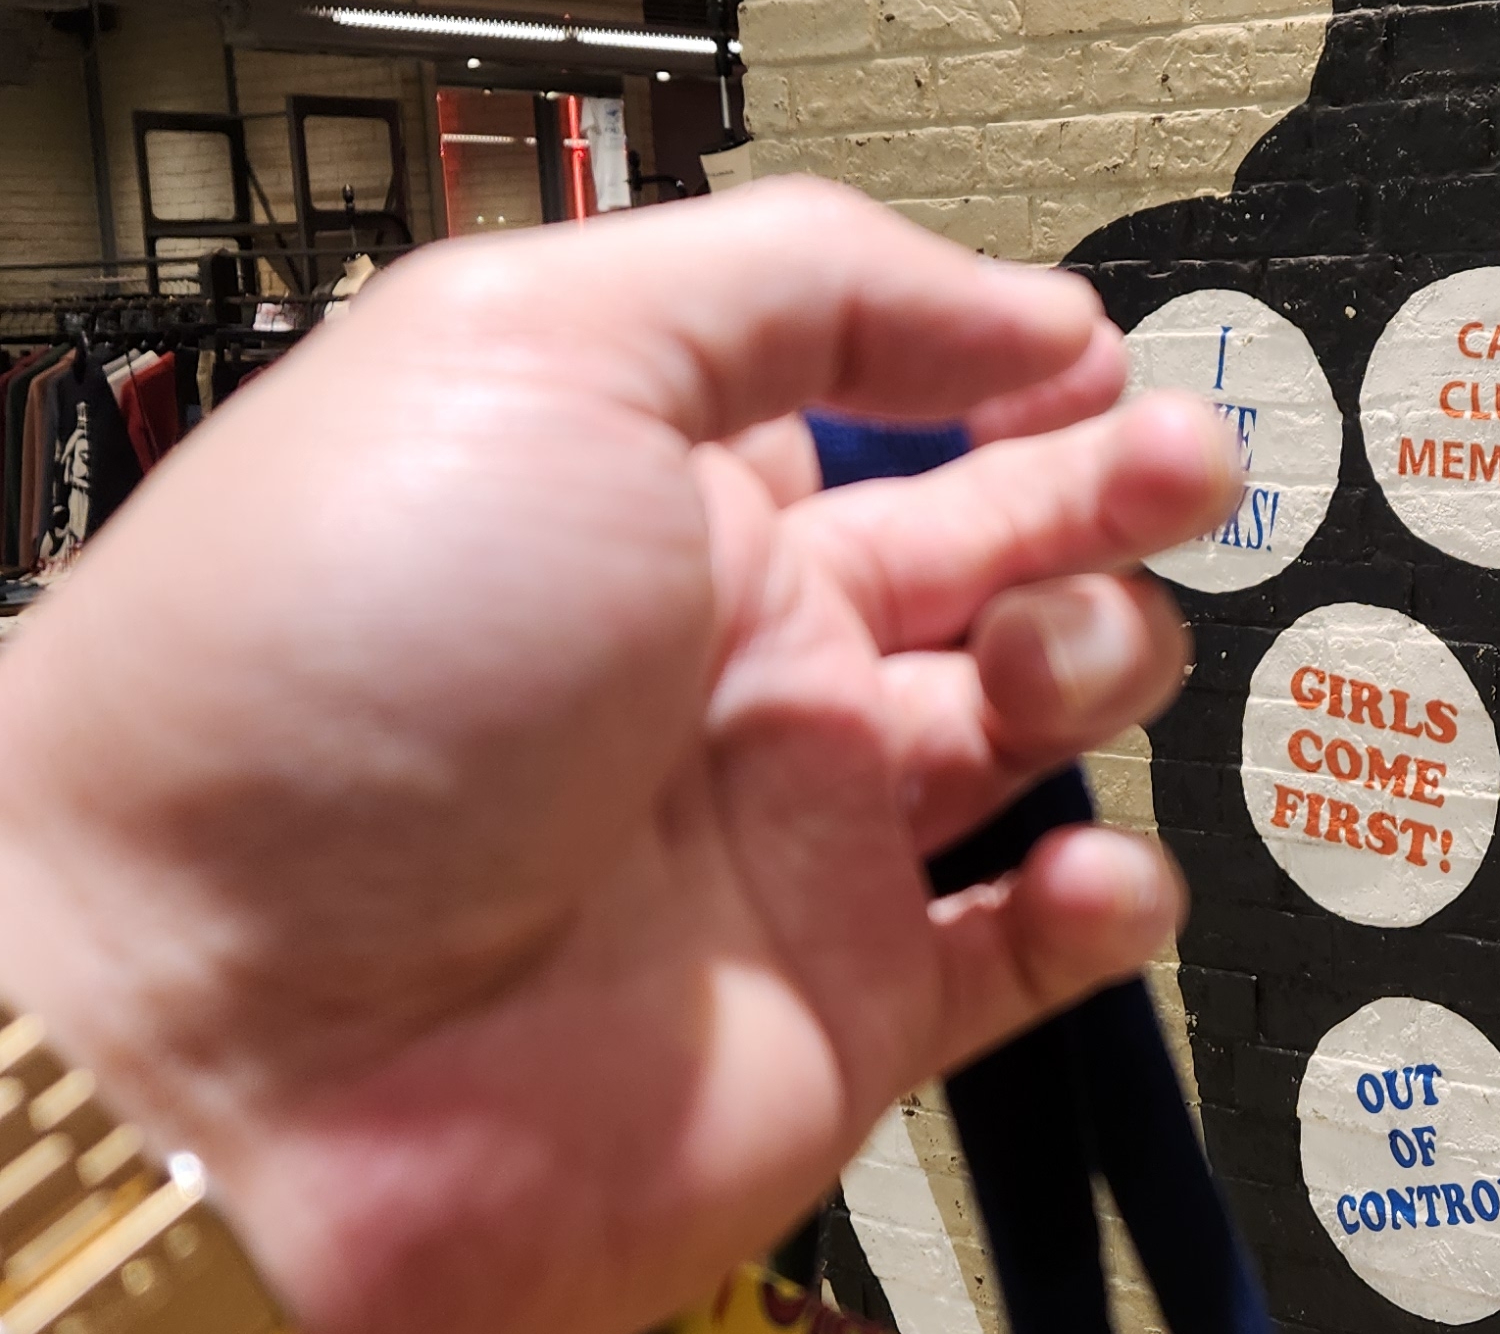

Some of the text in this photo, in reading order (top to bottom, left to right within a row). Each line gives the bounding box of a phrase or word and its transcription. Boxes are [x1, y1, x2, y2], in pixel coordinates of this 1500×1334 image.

[1213, 325, 1233, 391] I
[1290, 665, 1459, 745] GIRLS
[1287, 728, 1447, 809] COME
[1270, 782, 1454, 875] FIRST!
[1356, 1063, 1443, 1114] OUT
[1387, 1126, 1438, 1169] OF
